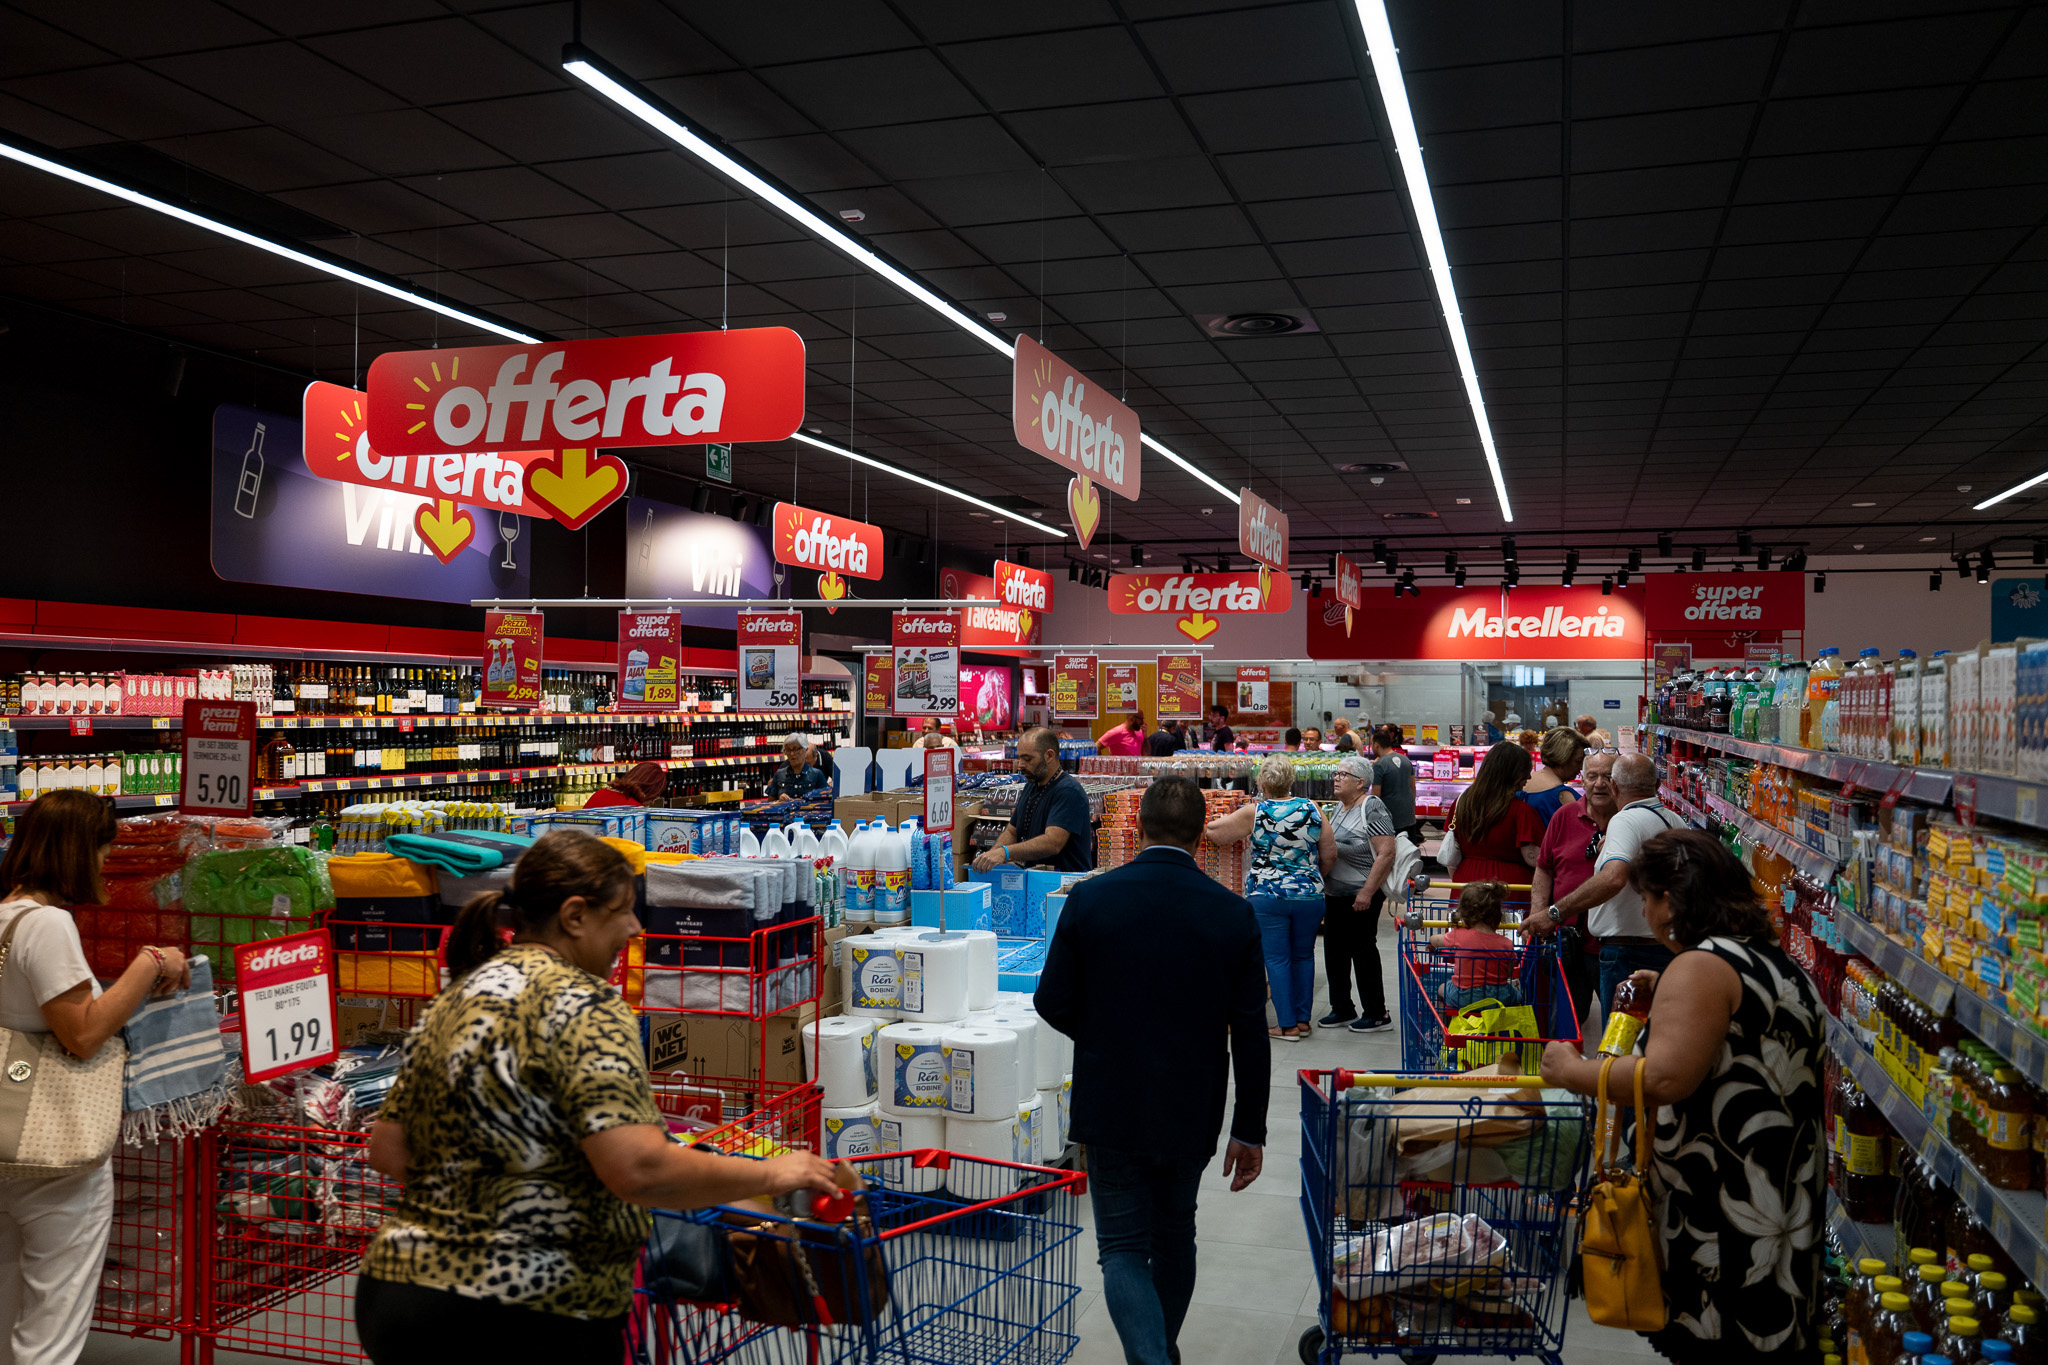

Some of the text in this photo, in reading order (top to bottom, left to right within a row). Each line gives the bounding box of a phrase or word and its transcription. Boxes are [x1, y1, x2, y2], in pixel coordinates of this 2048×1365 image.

[433, 350, 727, 447] offerta
[1041, 375, 1125, 486] offerta
[343, 482, 434, 556] Vin
[1250, 504, 1282, 566] offerta
[795, 516, 869, 574] offerta
[692, 544, 742, 598] Vini
[1005, 568, 1046, 609] offerta
[1137, 576, 1261, 612] offerta
[1695, 585, 1764, 605] super
[1684, 599, 1763, 621] offerta
[503, 619, 527, 627] PREZZI
[636, 615, 670, 628] super
[746, 617, 794, 632] offerta
[902, 617, 953, 634] offerta
[1448, 605, 1625, 639] Macelleria
[496, 626, 532, 636] APERTURA
[629, 624, 670, 638] offerta
[627, 666, 645, 680] AJAX
[751, 662, 769, 673] General
[1064, 662, 1088, 670] offerta
[1240, 668, 1266, 676] offerta
[898, 671, 911, 683] NET
[915, 670, 929, 682] NET
[506, 683, 539, 700] 2,99€
[1160, 694, 1180, 704] 5,49€
[199, 706, 241, 721] prezzi
[202, 718, 238, 733] fermi
[932, 753, 948, 765] prezzi
[197, 773, 240, 804] 5,90
[931, 801, 949, 825] 6,69
[249, 943, 319, 972] offerta
[871, 974, 895, 985] Ren
[255, 990, 273, 1001] TELO
[274, 987, 294, 999] MARE
[266, 1017, 320, 1062] 1,99
[656, 1022, 682, 1044] WC
[783, 1036, 794, 1045] WC
[654, 1036, 687, 1062] NET
[783, 1042, 796, 1051] NET
[917, 1071, 941, 1082] Ren
[848, 1144, 871, 1155] Ren
